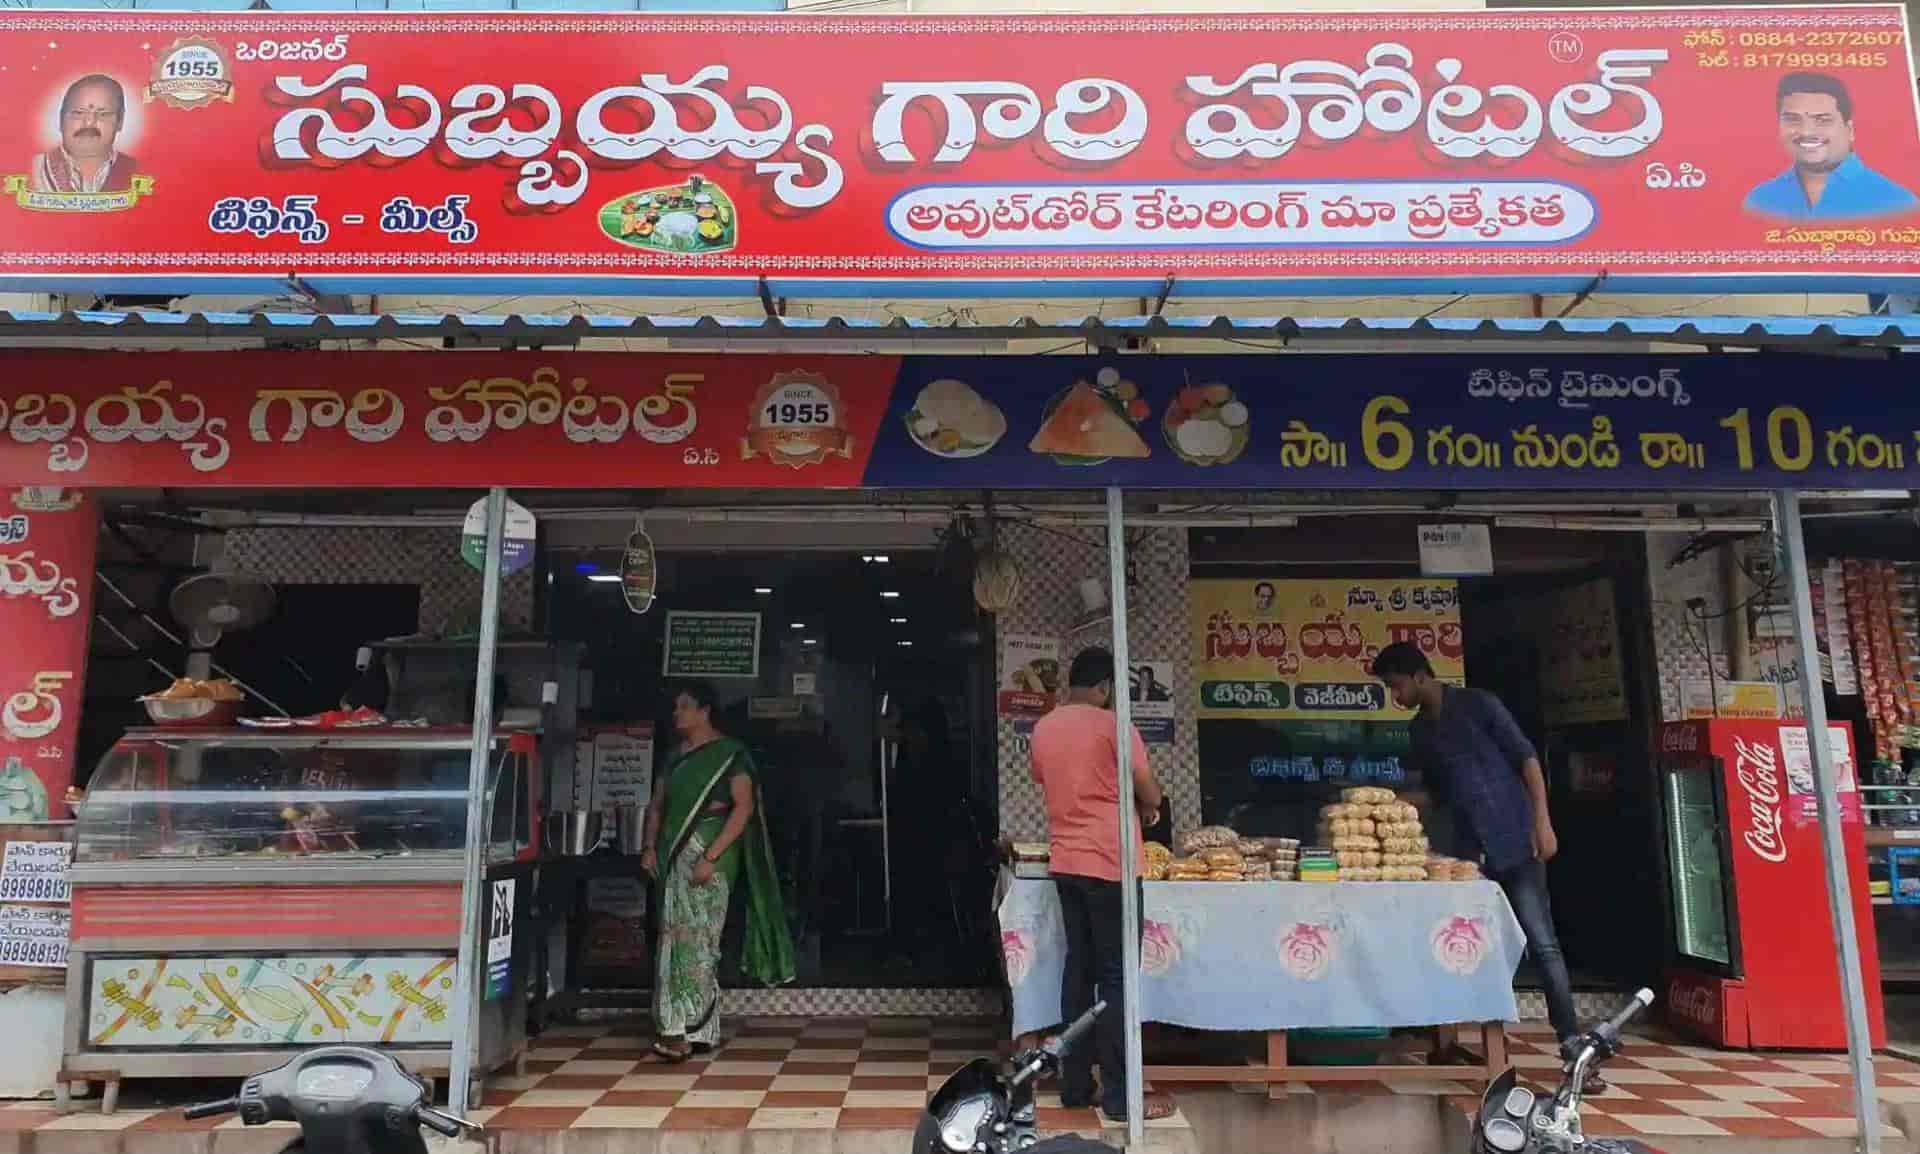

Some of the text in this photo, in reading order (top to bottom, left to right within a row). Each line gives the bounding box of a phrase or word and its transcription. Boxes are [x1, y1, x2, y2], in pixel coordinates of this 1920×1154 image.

[166, 61, 219, 76] 1955
[1743, 53, 1888, 68] 8179993485
[273, 43, 1668, 207] సుబ్బయ్య గారి హోటల్
[1645, 162, 1706, 188] ఏ.సి
[210, 196, 328, 243] టిఫిన్స్
[381, 196, 478, 243] మీల్స్
[1132, 188, 1309, 230] కేటరింగ్
[1320, 195, 1396, 228] మా
[1408, 187, 1566, 239] ప్రత్యేకత
[1467, 368, 1551, 402] టిఫిన్
[0, 367, 704, 472] బ్బయ్య గారి హోటల్
[766, 403, 829, 423] 1955
[1361, 394, 1414, 471] 6
[1511, 415, 1620, 468] నుండి
[1719, 405, 1814, 471] 10
